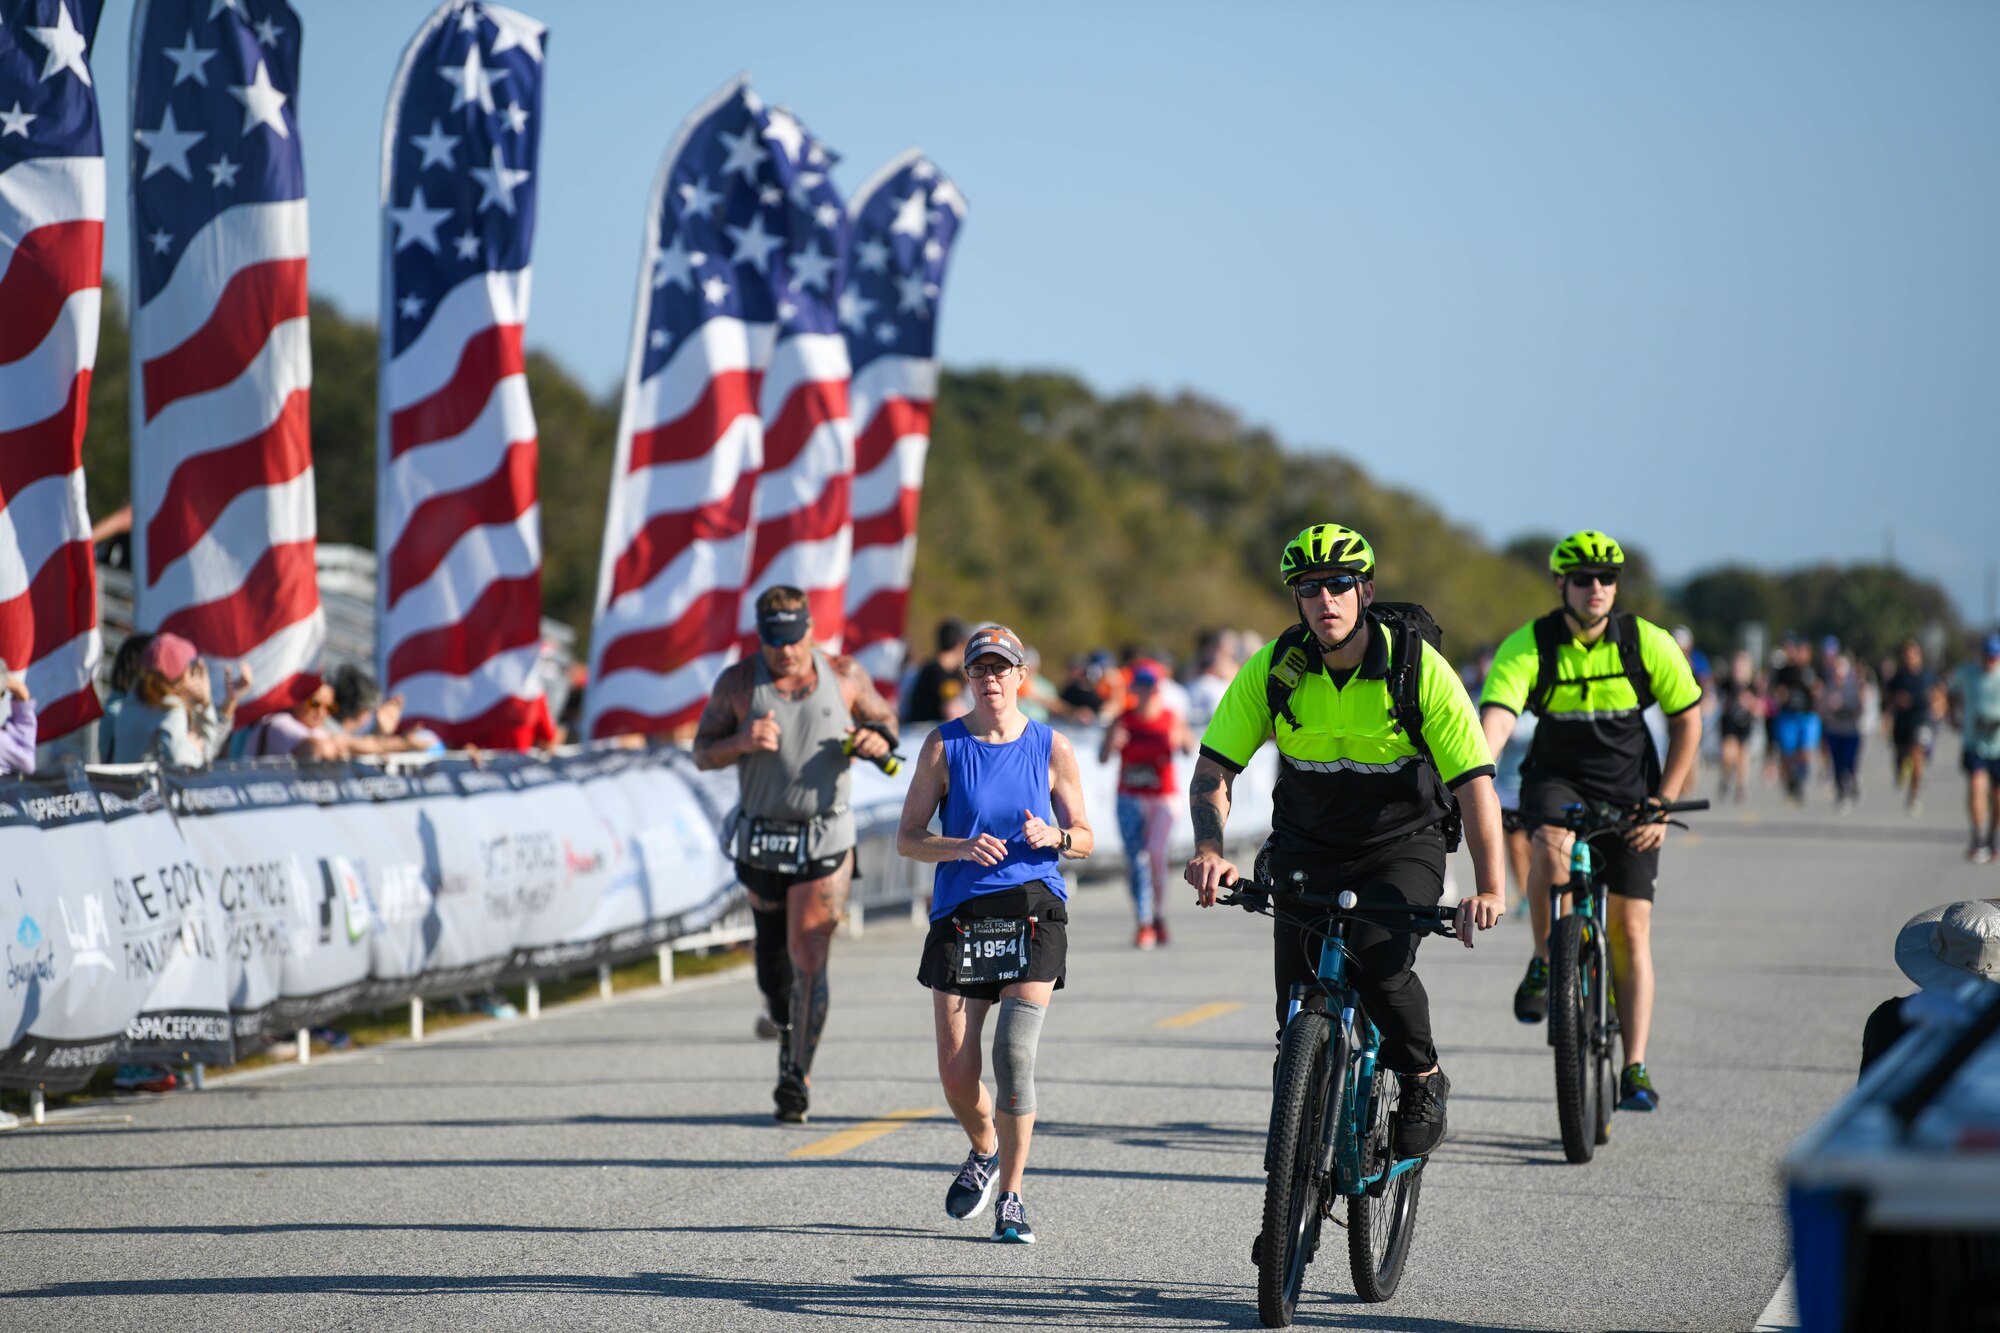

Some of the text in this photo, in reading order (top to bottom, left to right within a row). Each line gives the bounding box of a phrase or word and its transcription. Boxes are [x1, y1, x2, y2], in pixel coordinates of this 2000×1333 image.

[760, 834, 800, 853] 1077
[973, 938, 1017, 958] 1954
[998, 970, 1019, 980] 1954
